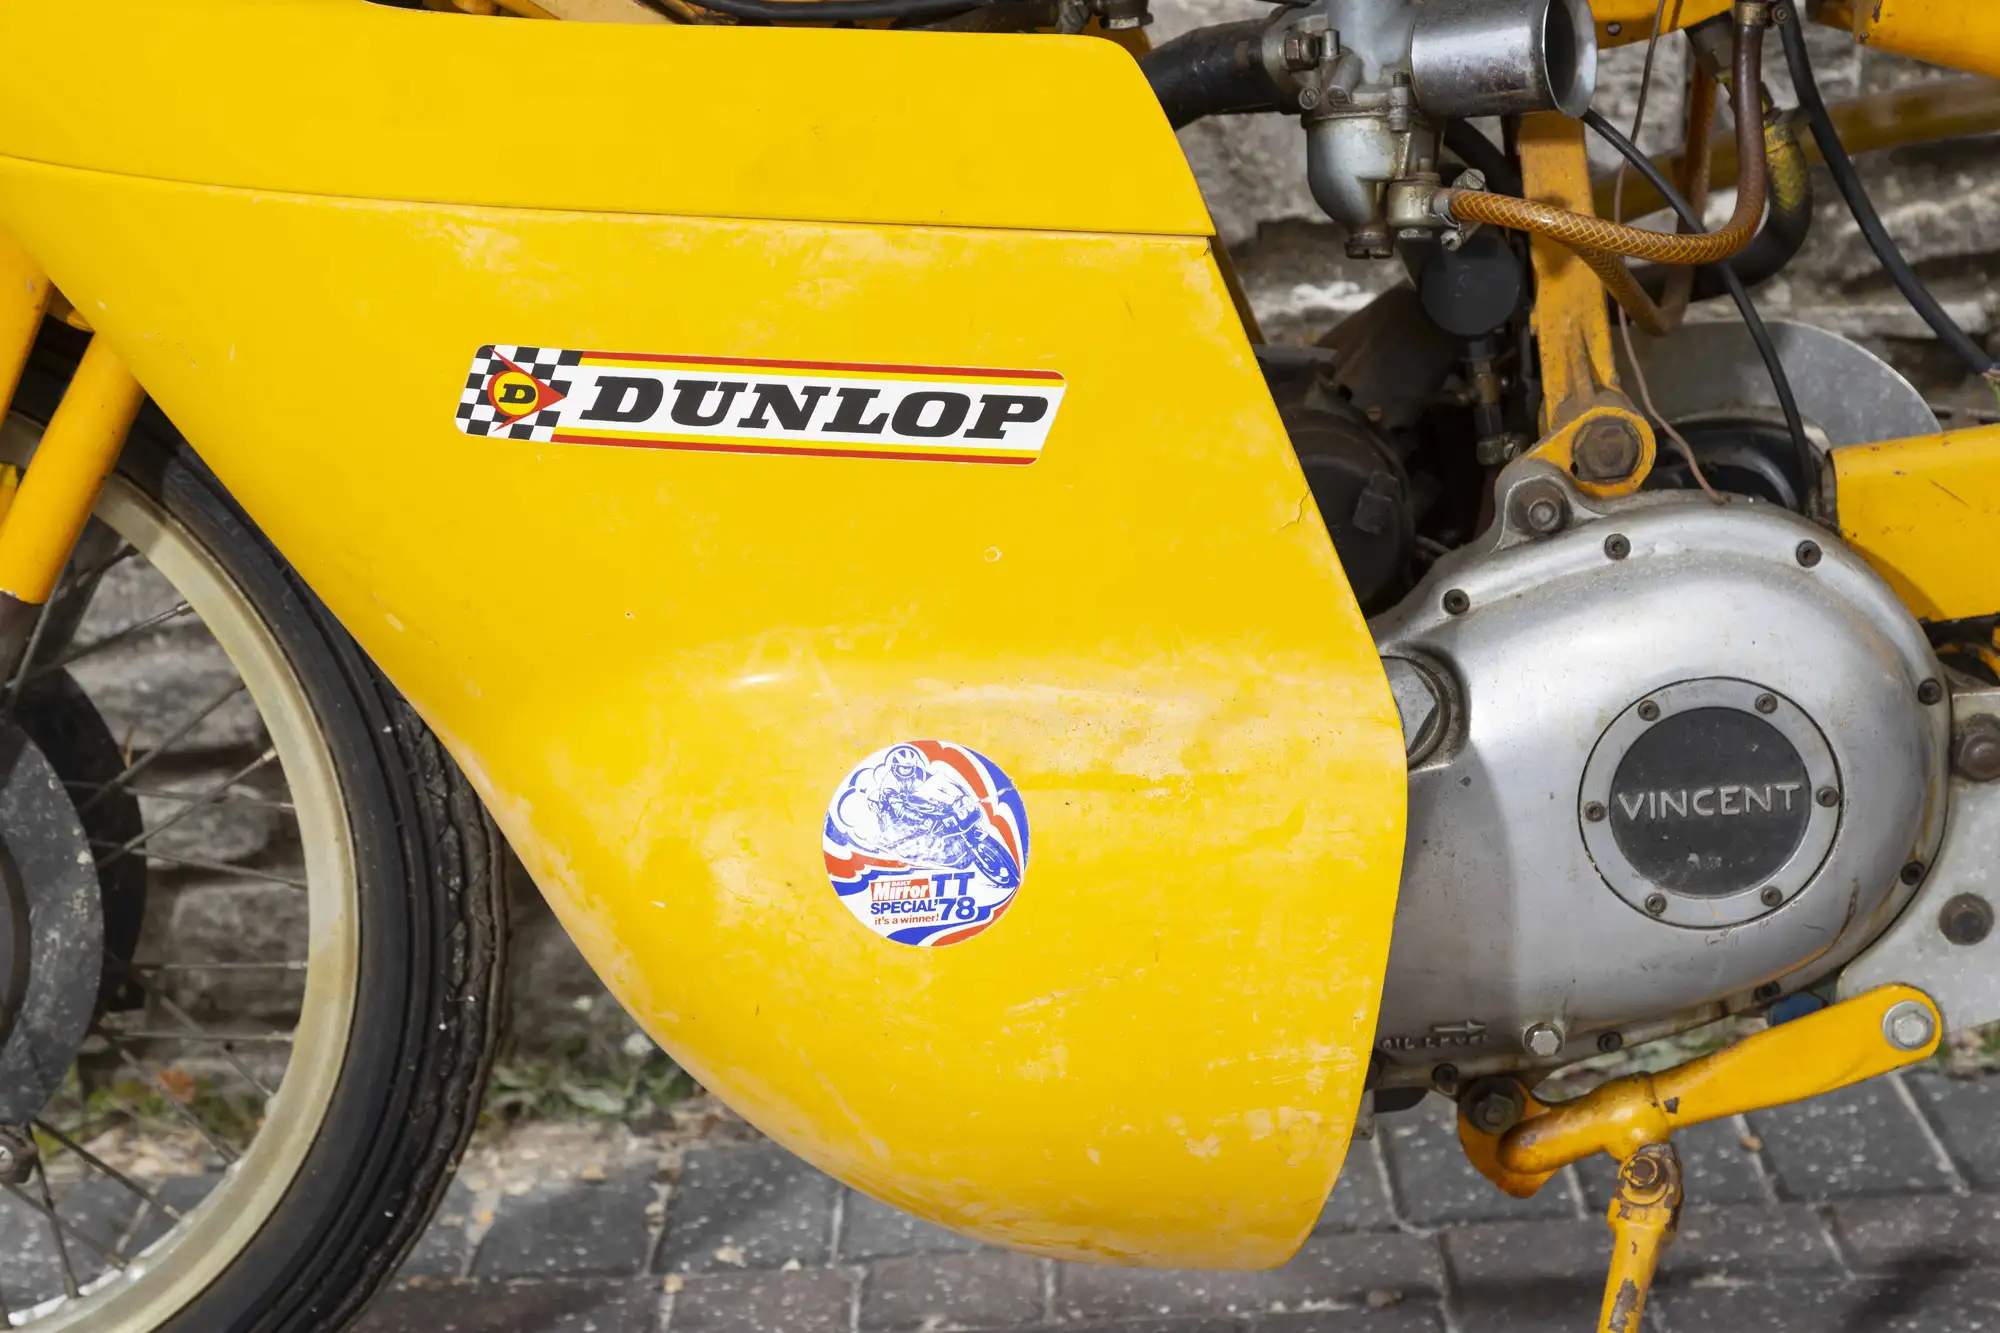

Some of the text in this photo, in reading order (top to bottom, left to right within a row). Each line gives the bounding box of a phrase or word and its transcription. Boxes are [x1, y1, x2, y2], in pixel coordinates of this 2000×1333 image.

[498, 383, 537, 404] D
[578, 375, 1049, 440] DUNLOP
[1617, 782, 1801, 821] VINCENT
[873, 871, 975, 901] Mirror TT
[874, 912, 939, 926] it's a winner!
[1381, 1037, 1415, 1051] OIL
